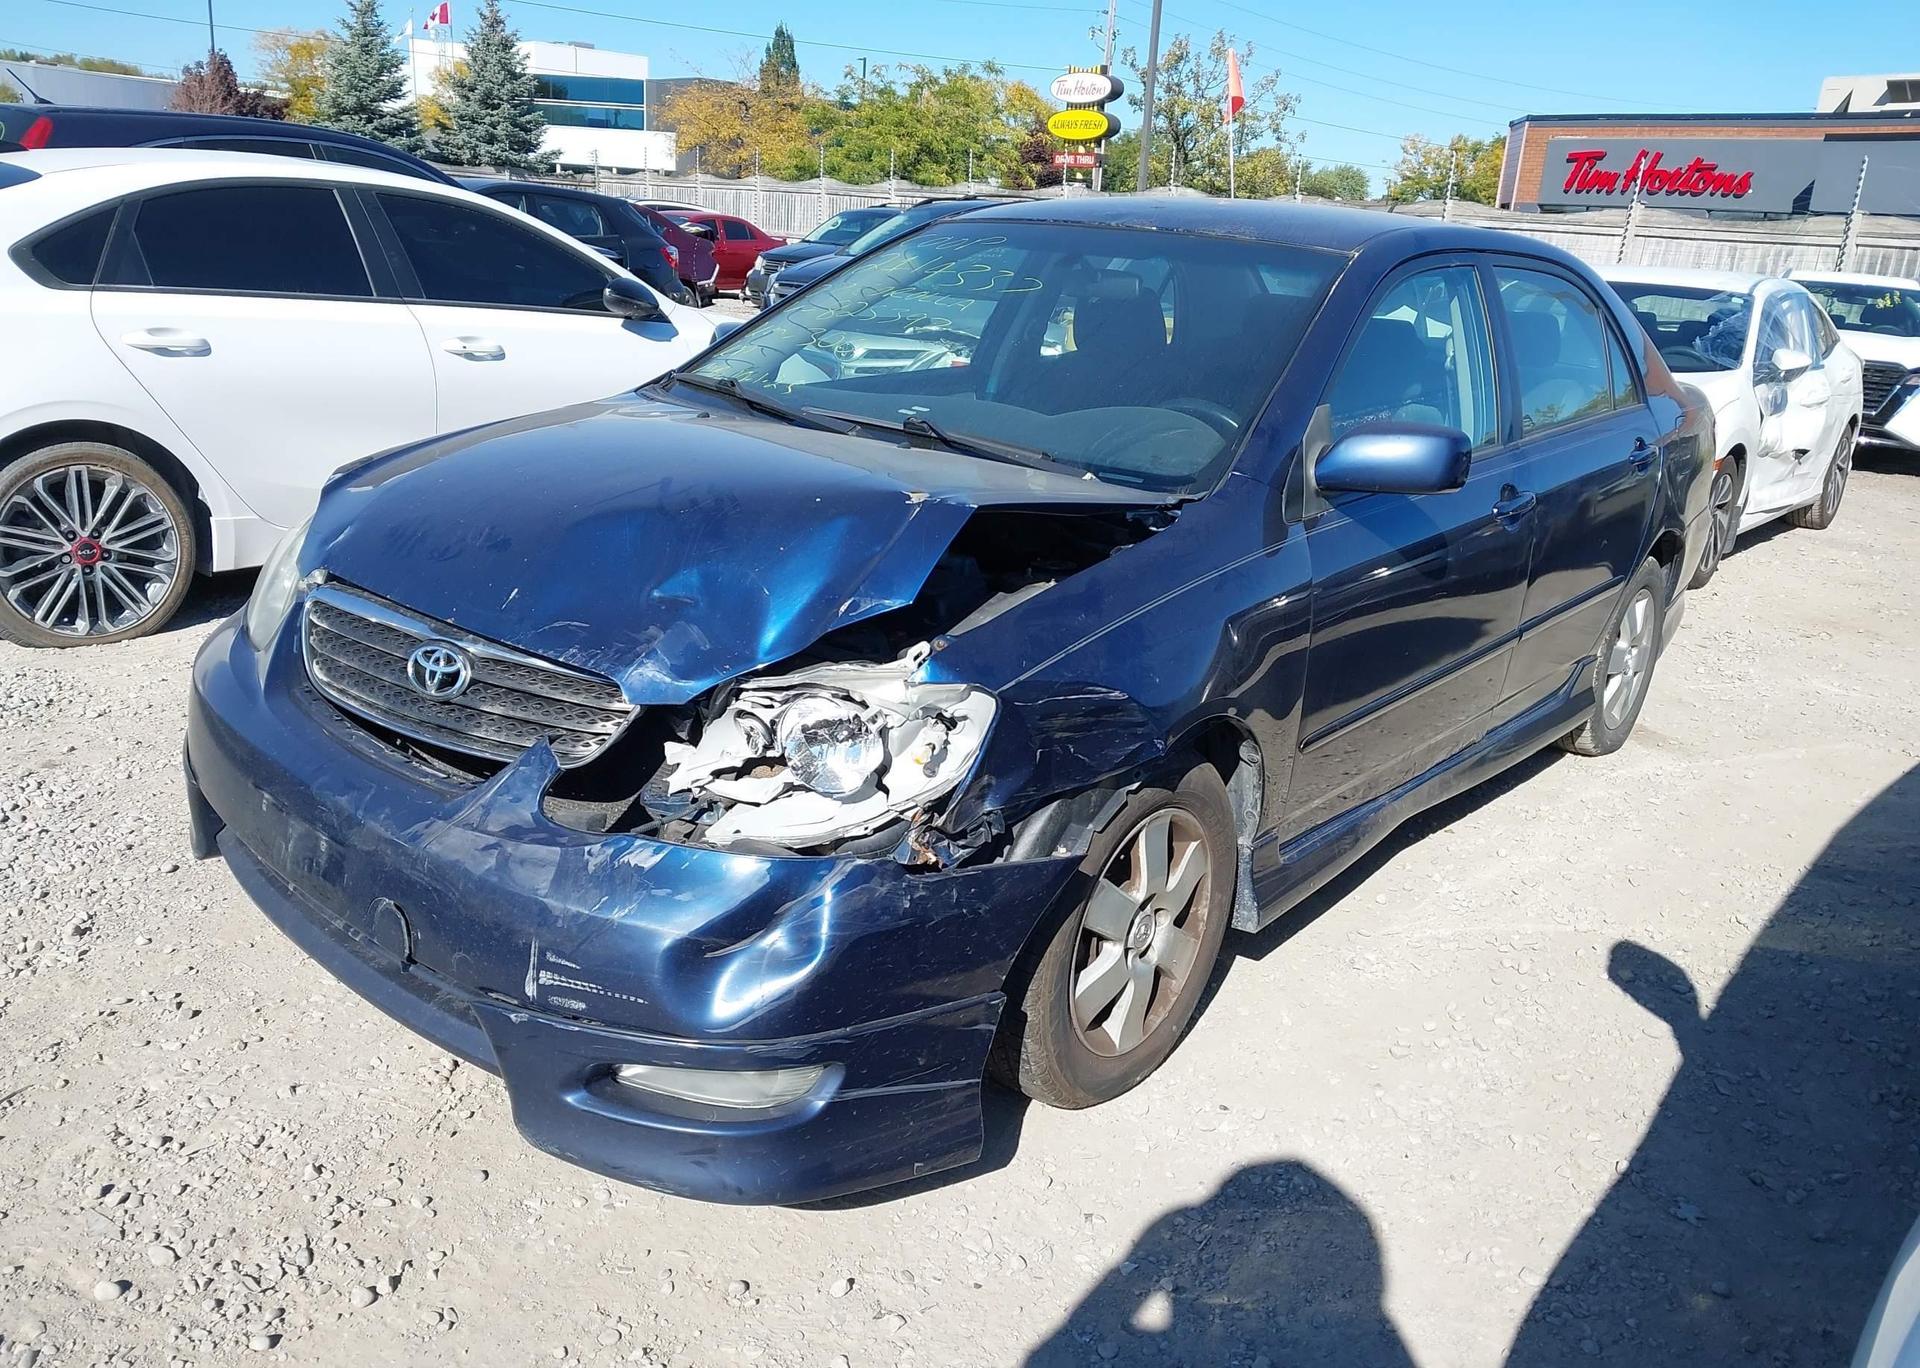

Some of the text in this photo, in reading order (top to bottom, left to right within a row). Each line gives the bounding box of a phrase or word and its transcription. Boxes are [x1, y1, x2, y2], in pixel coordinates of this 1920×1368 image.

[1056, 79, 1106, 95] Tim Hortons
[1052, 119, 1104, 129] ALWAYS FRESH
[1055, 155, 1095, 164] DRVE THRU
[1563, 149, 1755, 198] Tim Hortons
